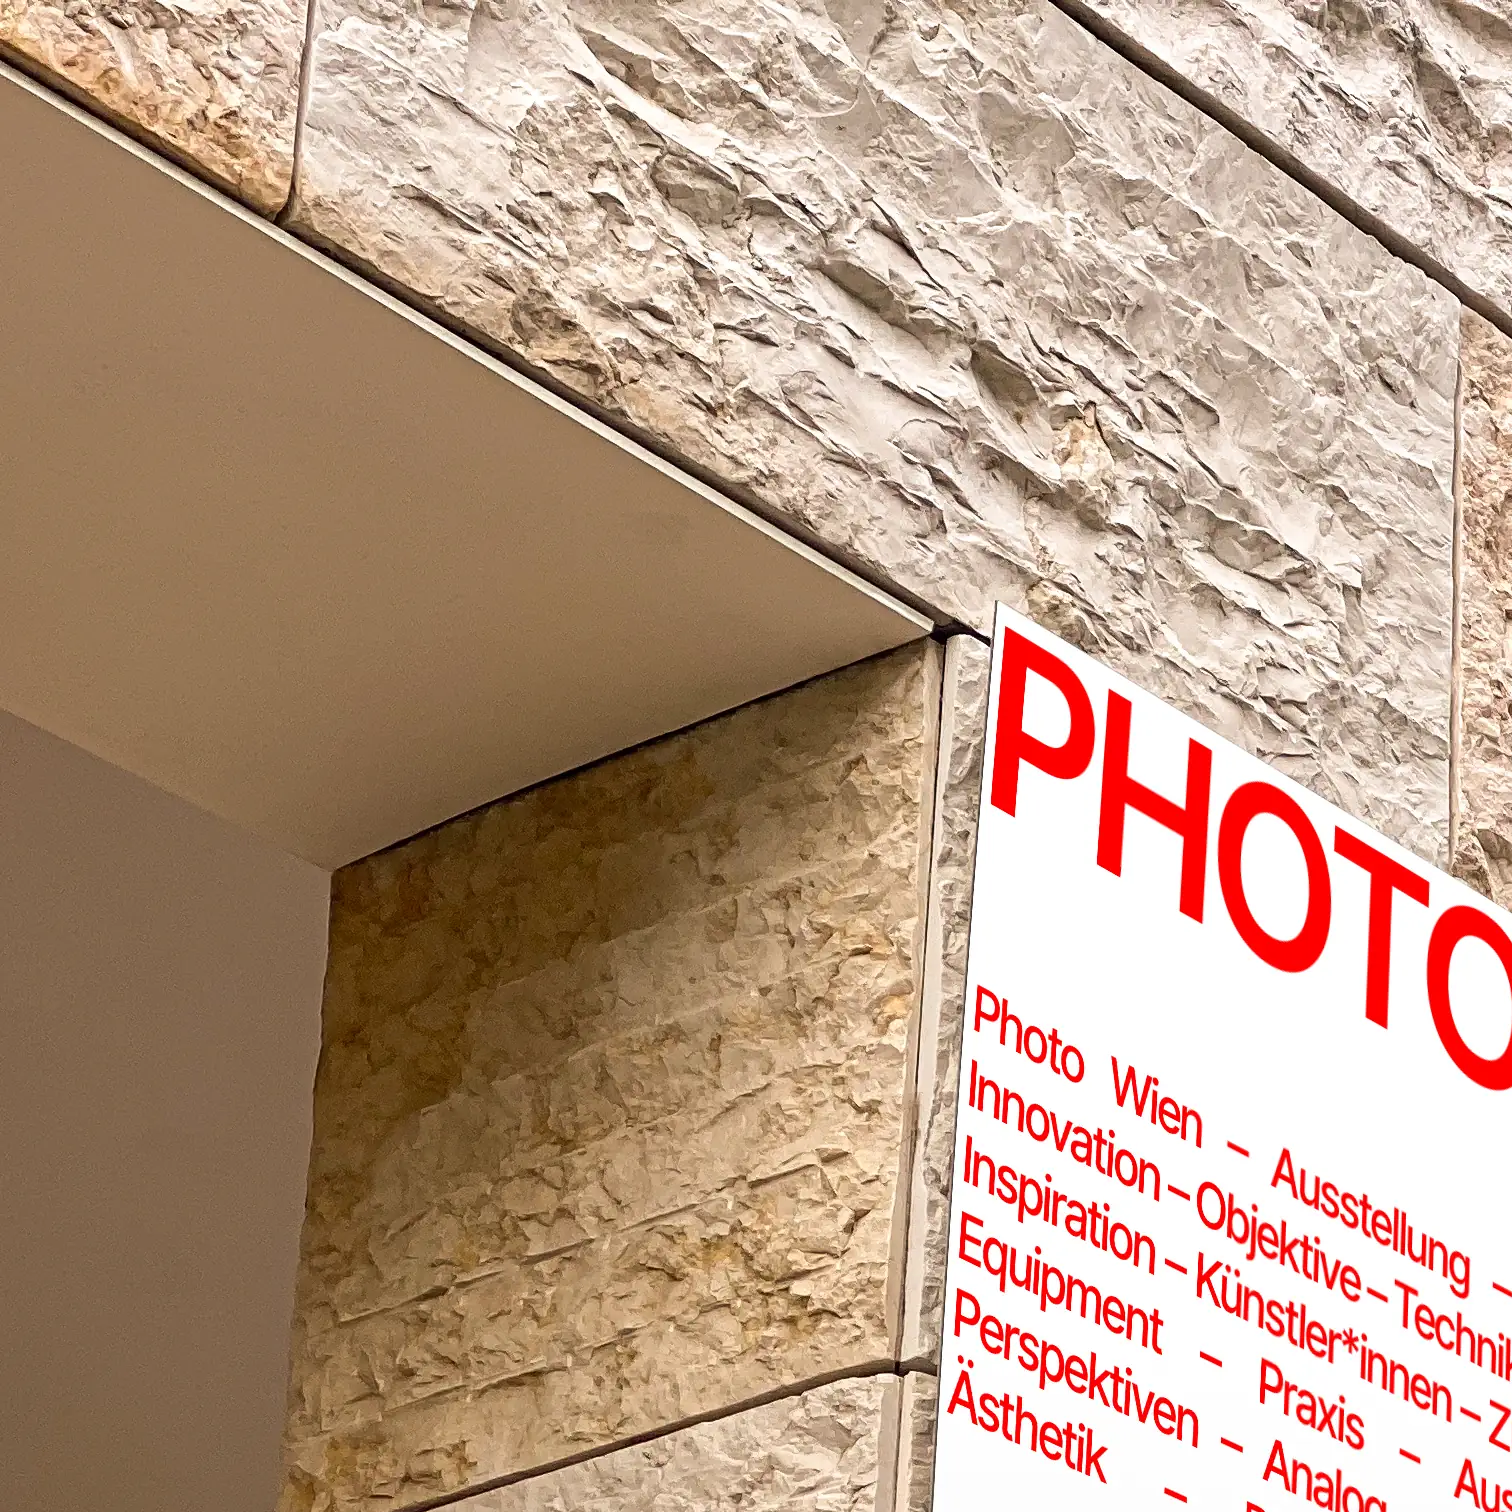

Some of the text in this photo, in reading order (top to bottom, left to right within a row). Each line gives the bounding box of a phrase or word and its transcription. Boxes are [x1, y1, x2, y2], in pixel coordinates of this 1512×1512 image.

[964, 1135, 1155, 1275] Inspiration
[969, 1059, 1160, 1202] Innovation
[1197, 1182, 1361, 1302] Objektive
[974, 985, 1084, 1083] Photo
[1111, 1056, 1202, 1148] Wien
[1271, 1148, 1470, 1299] Ausstellung
[947, 1355, 1108, 1483] Ästhetik
[954, 1288, 1198, 1448] Perspektiven
[959, 1211, 1164, 1355] Equipment
[1260, 1358, 1364, 1450] Praxis
